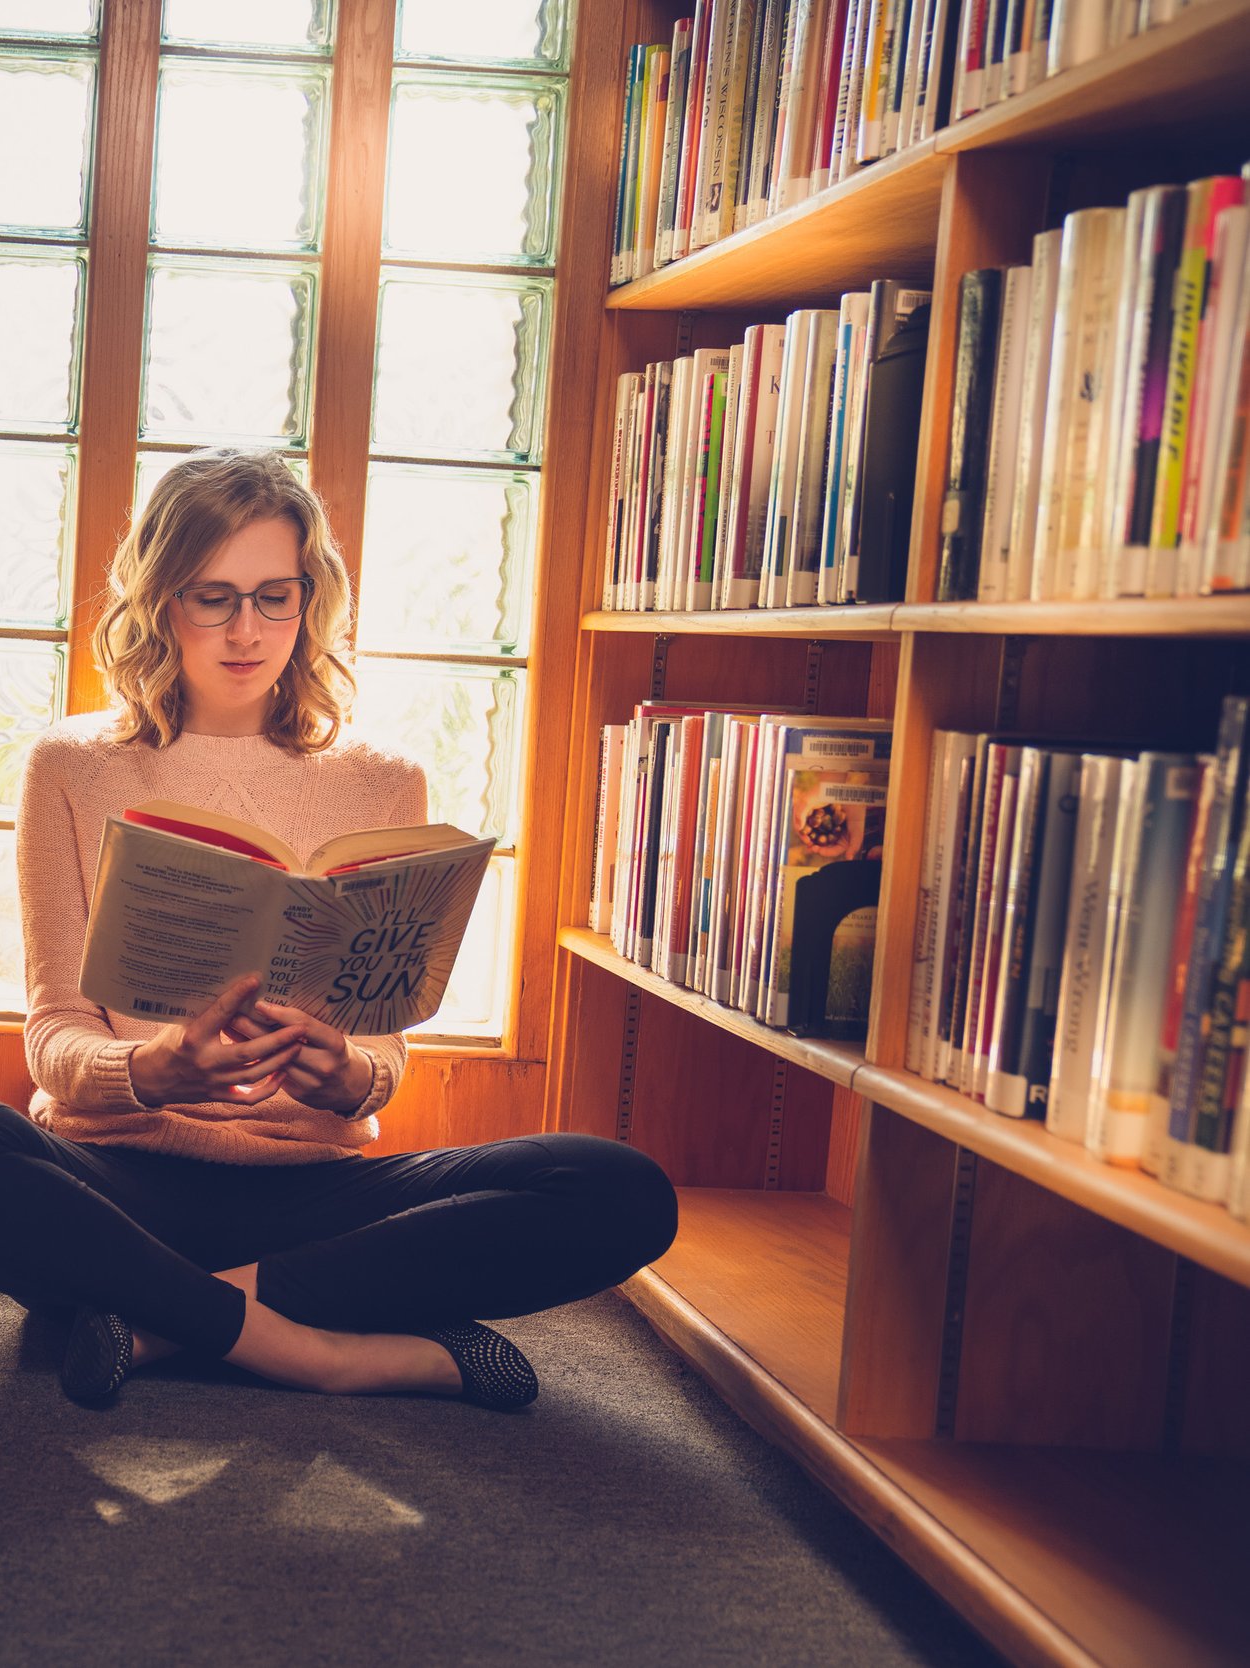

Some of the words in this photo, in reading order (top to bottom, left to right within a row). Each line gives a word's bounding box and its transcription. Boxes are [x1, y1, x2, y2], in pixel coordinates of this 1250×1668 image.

[711, 82, 728, 177] WISCONSIN
[729, 356, 737, 394] NOTHING
[931, 876, 941, 905] THIS
[380, 907, 419, 927] I'LL
[913, 888, 931, 960] AMERICAN
[1076, 879, 1098, 949] Went
[350, 921, 436, 954] GIVE
[925, 911, 939, 994] DEPRESSION
[269, 970, 297, 983] YOU
[271, 956, 299, 969] GIVE
[339, 955, 383, 972] YOU
[393, 950, 430, 969] THE
[266, 983, 291, 996] THE
[326, 966, 427, 1004] SUN
[1063, 950, 1090, 1054] Wrong
[1197, 991, 1233, 1114] CAREERS
